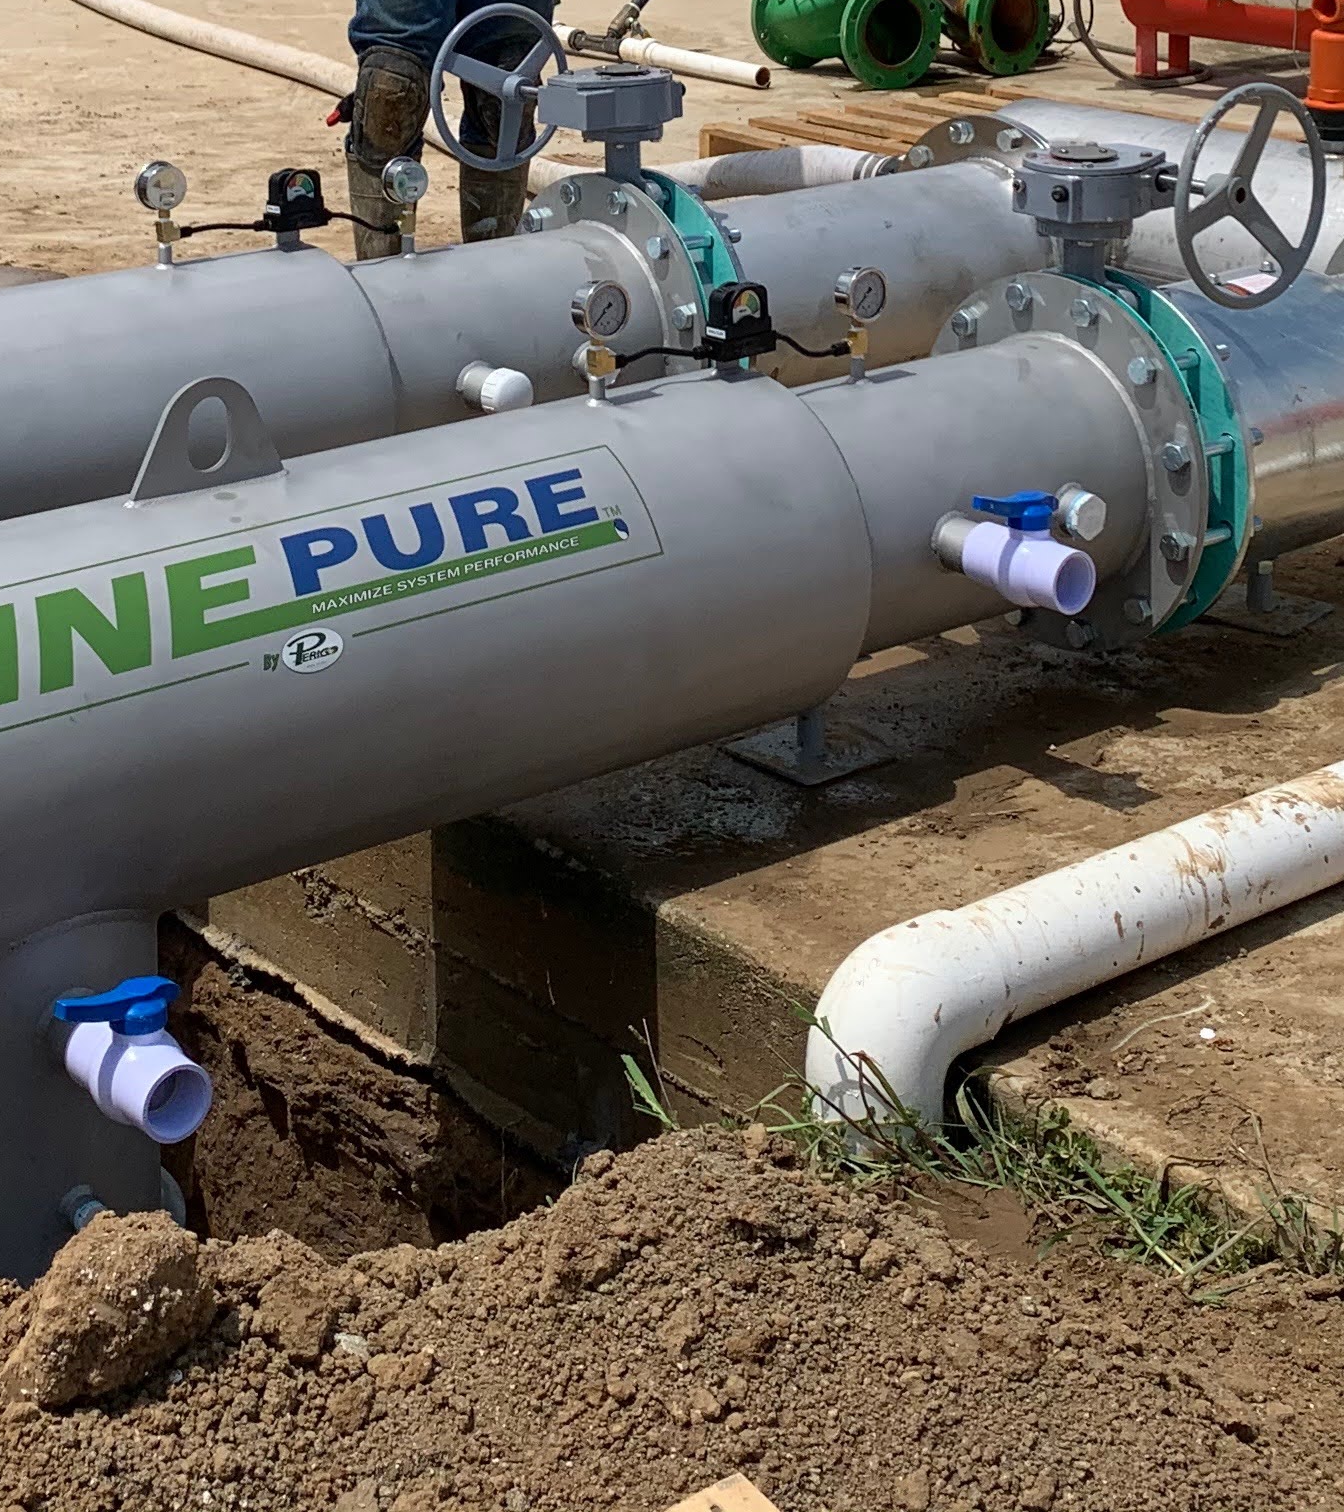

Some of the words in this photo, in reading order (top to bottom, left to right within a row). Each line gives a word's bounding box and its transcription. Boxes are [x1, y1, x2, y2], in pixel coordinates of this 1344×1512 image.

[312, 583, 393, 614] MAXIMIZE
[396, 566, 460, 592] SYSTEM
[464, 536, 580, 575] PERFORMANCE
[263, 653, 279, 672] By
